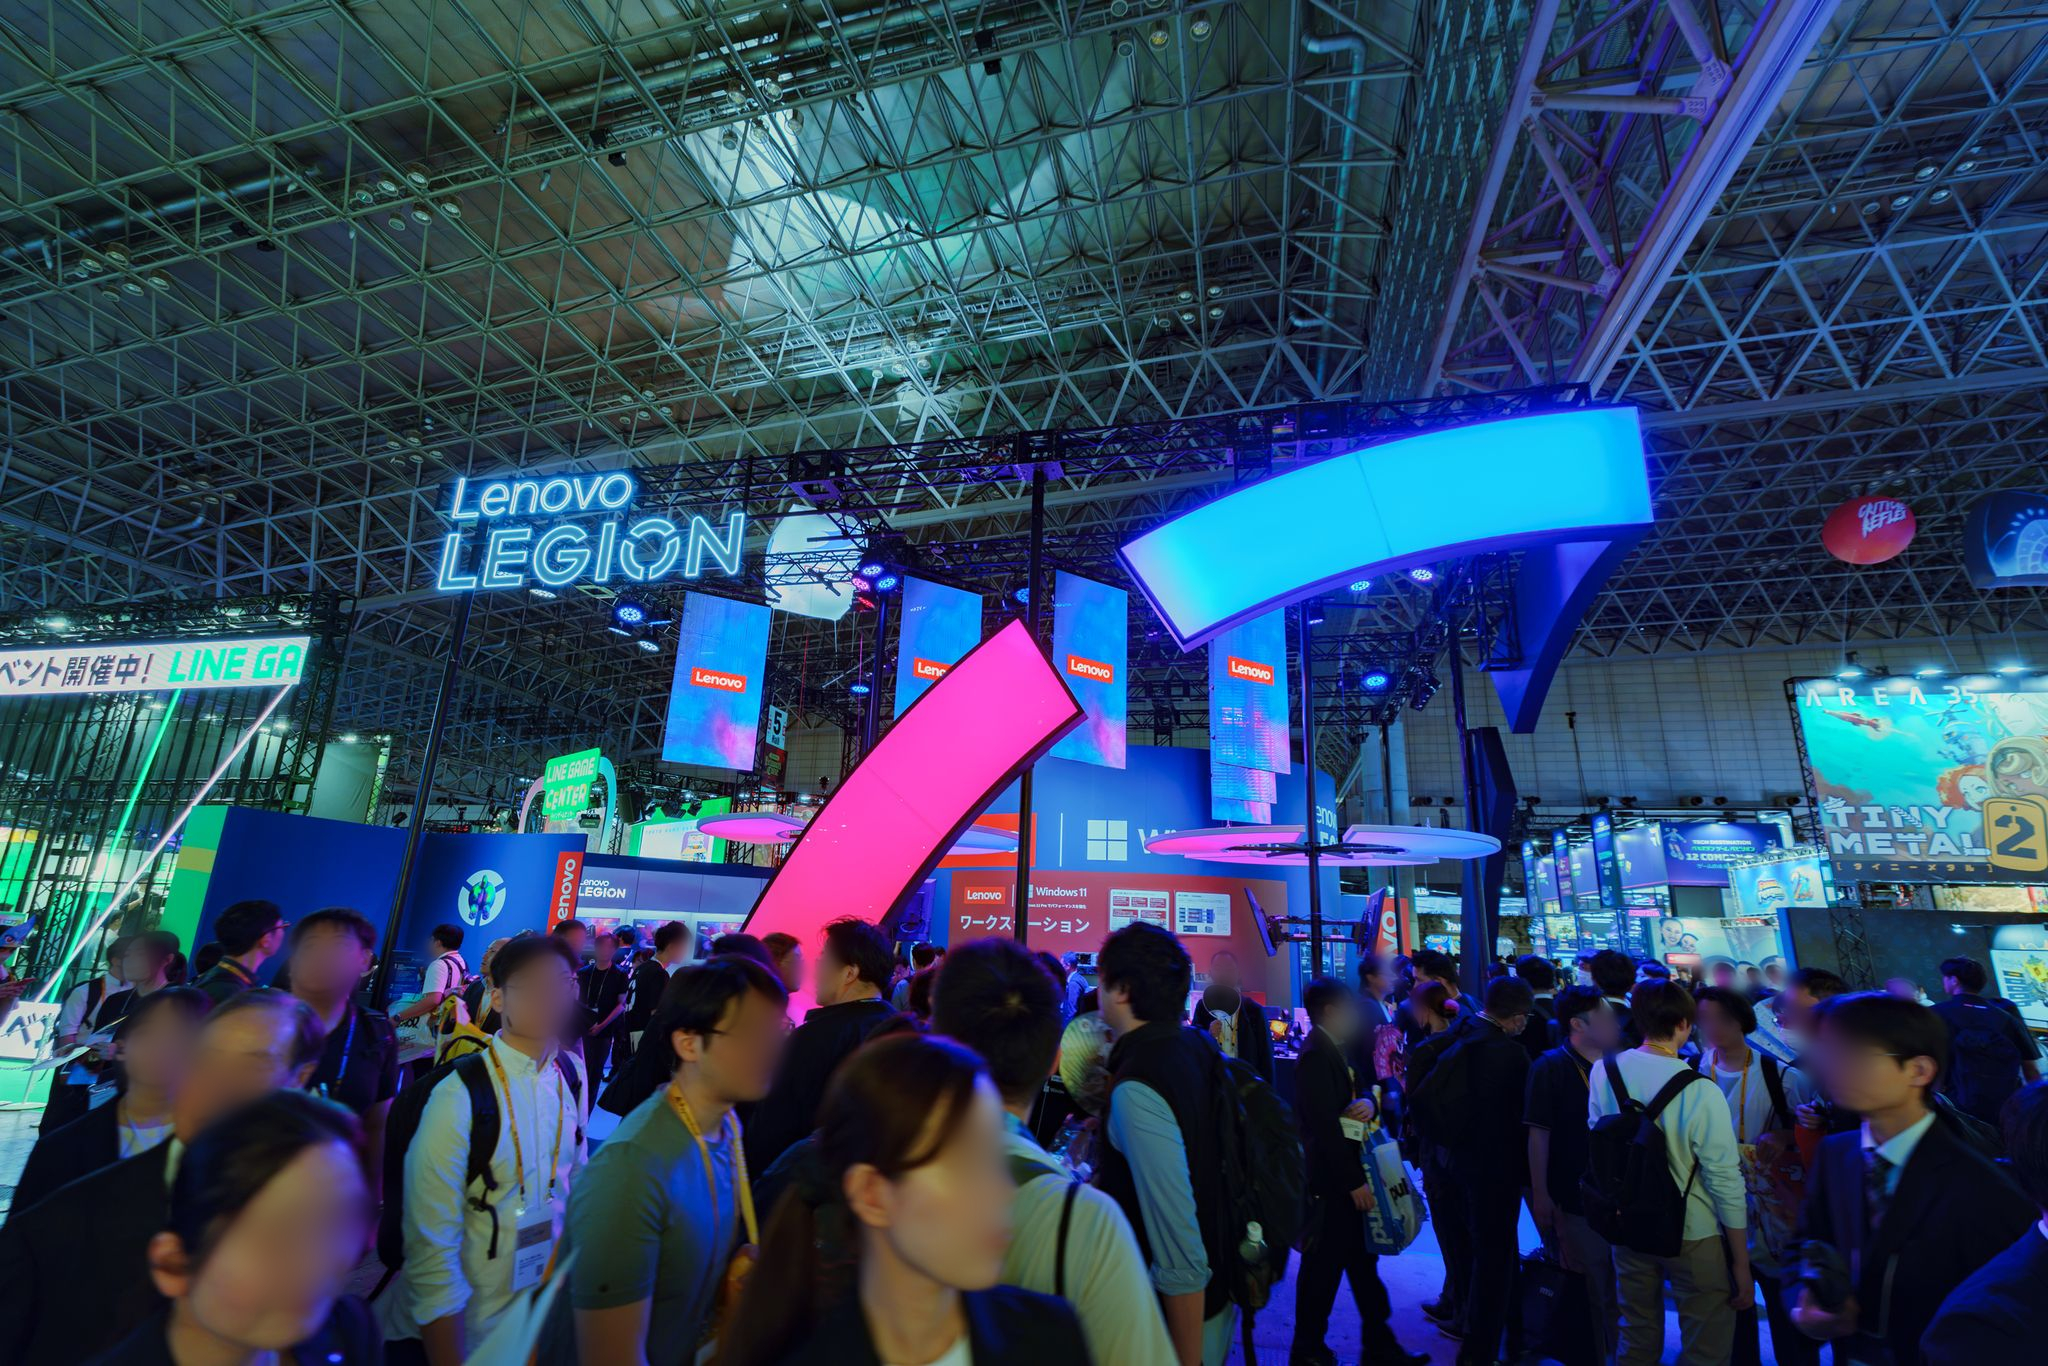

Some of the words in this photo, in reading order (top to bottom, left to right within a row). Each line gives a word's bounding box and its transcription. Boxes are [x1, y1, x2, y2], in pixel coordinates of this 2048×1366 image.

[451, 474, 632, 519] Lenovo
[437, 512, 746, 591] LEGION
[168, 647, 249, 683] LINE
[251, 645, 302, 680] GA
[917, 662, 946, 677] Leno
[1070, 658, 1110, 679] Lenovo
[1231, 660, 1271, 680] Lenovo
[695, 671, 743, 689] Lenovo
[774, 711, 782, 734] 5
[546, 762, 568, 783] LINE
[567, 757, 596, 779] GAME
[545, 783, 587, 811] CENTER
[1824, 798, 1953, 829] TINY
[1829, 832, 1992, 857] METAL
[1994, 814, 2038, 860] 2
[552, 858, 577, 930] enovo
[578, 886, 626, 899] LEGION
[967, 889, 1002, 900] Lenovo
[1035, 887, 1078, 897] Windows
[1079, 888, 1087, 897] 11
[960, 914, 1090, 934] ワークスーション
